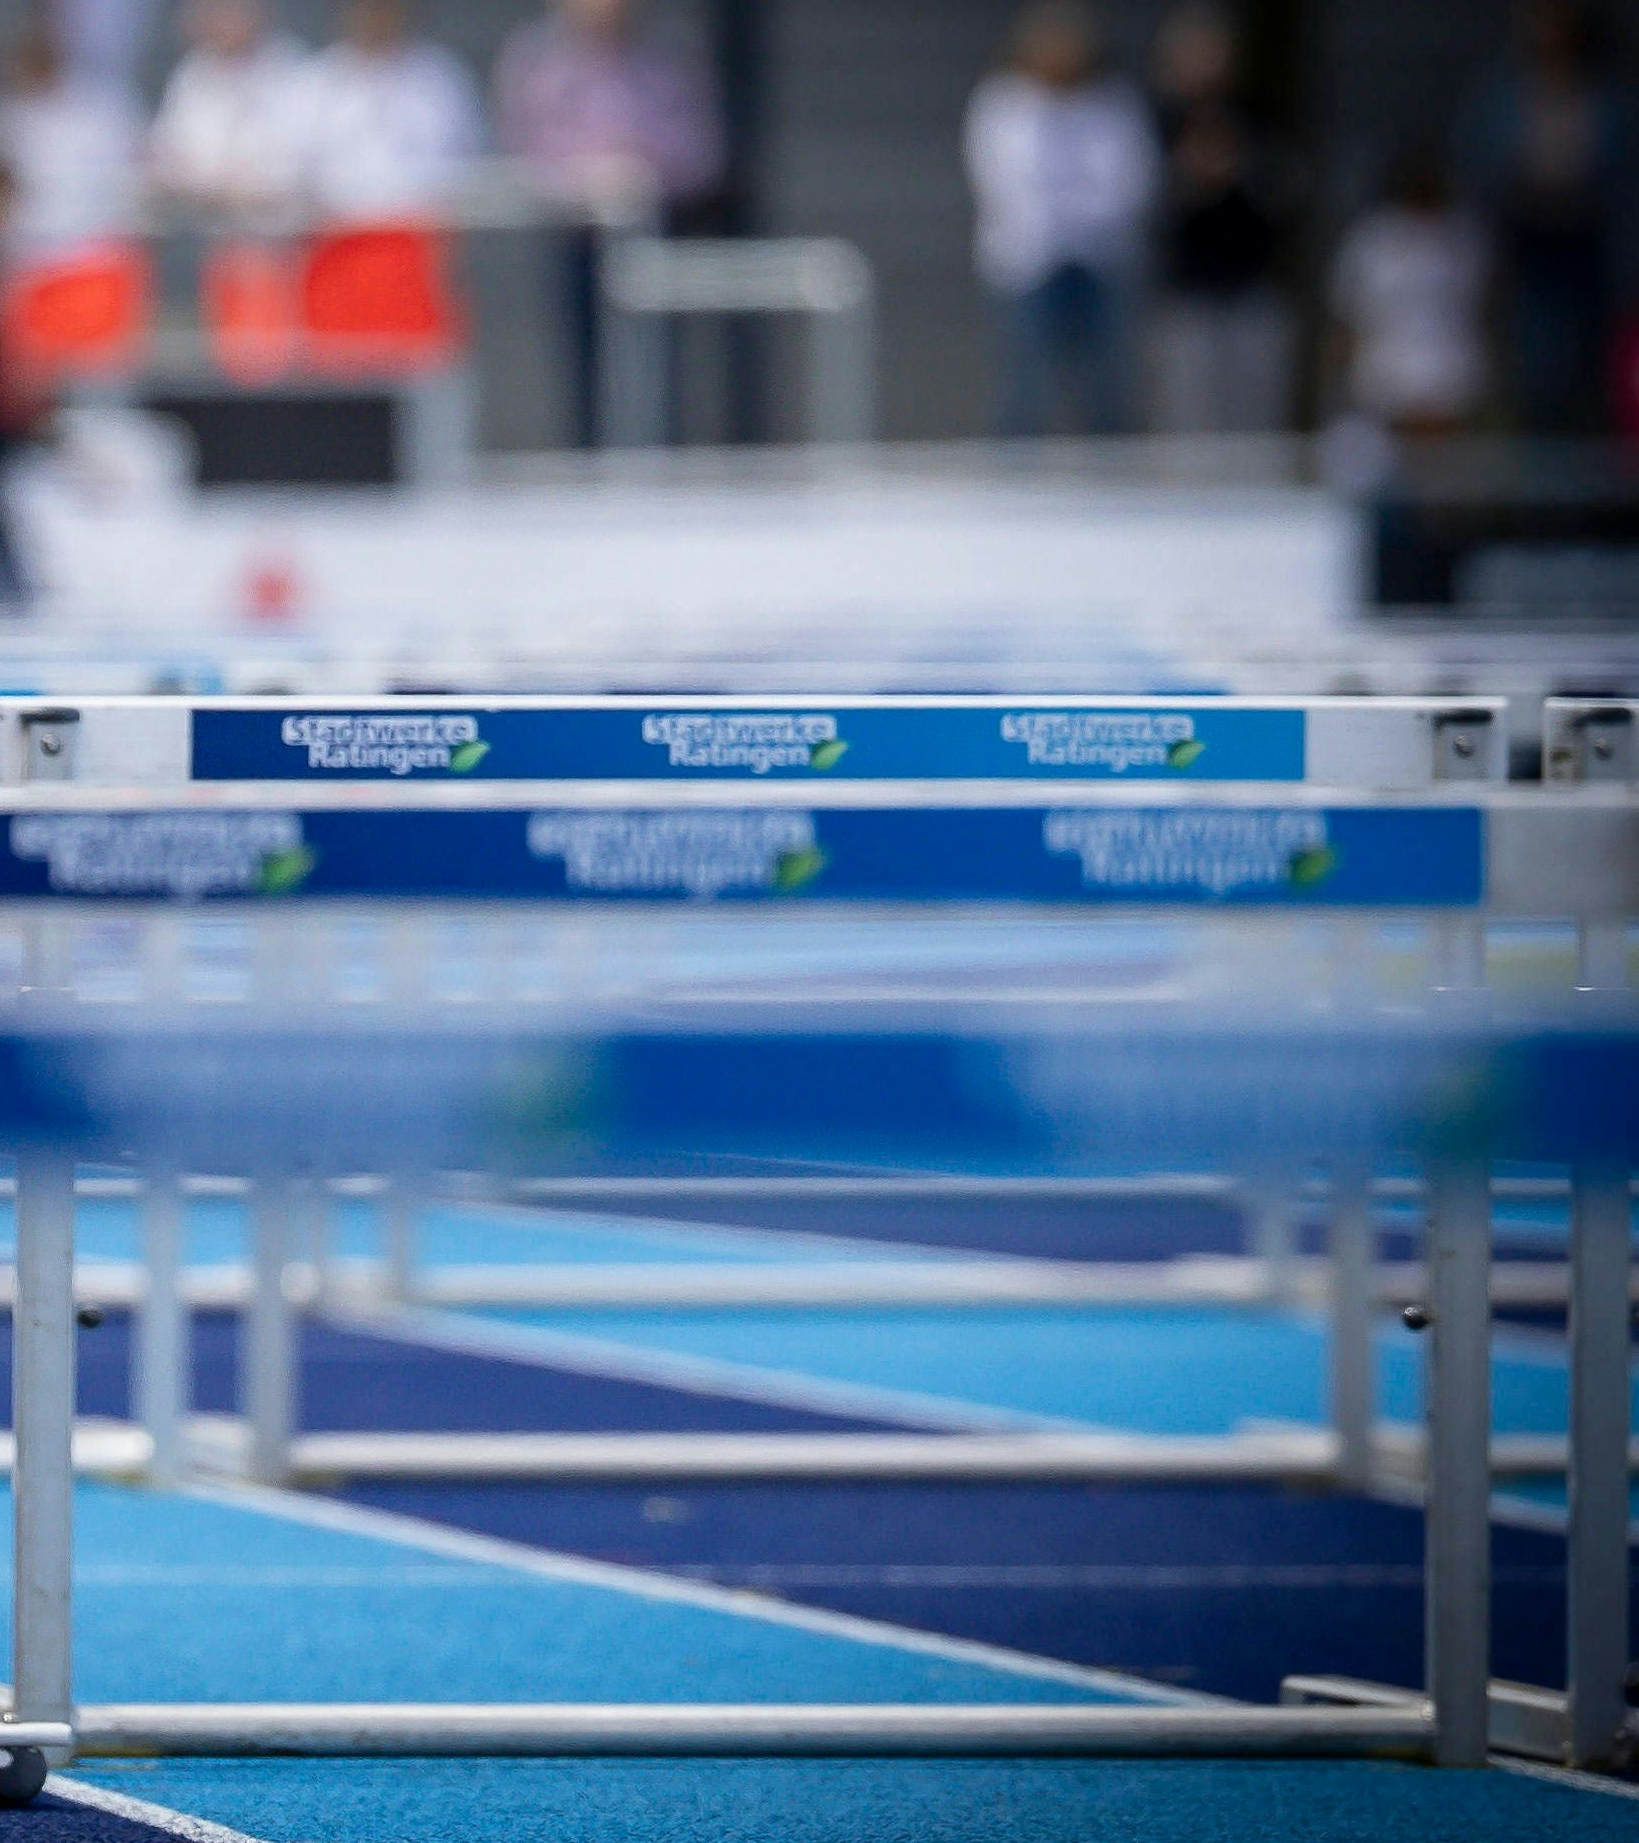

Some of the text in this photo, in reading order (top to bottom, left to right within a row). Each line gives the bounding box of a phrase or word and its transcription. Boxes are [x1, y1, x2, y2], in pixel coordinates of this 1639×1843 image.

[282, 715, 478, 746] Stadtwerke
[308, 741, 451, 775] Ratingen
[669, 740, 812, 774] Ratingen
[1027, 740, 1170, 772] Ratingen
